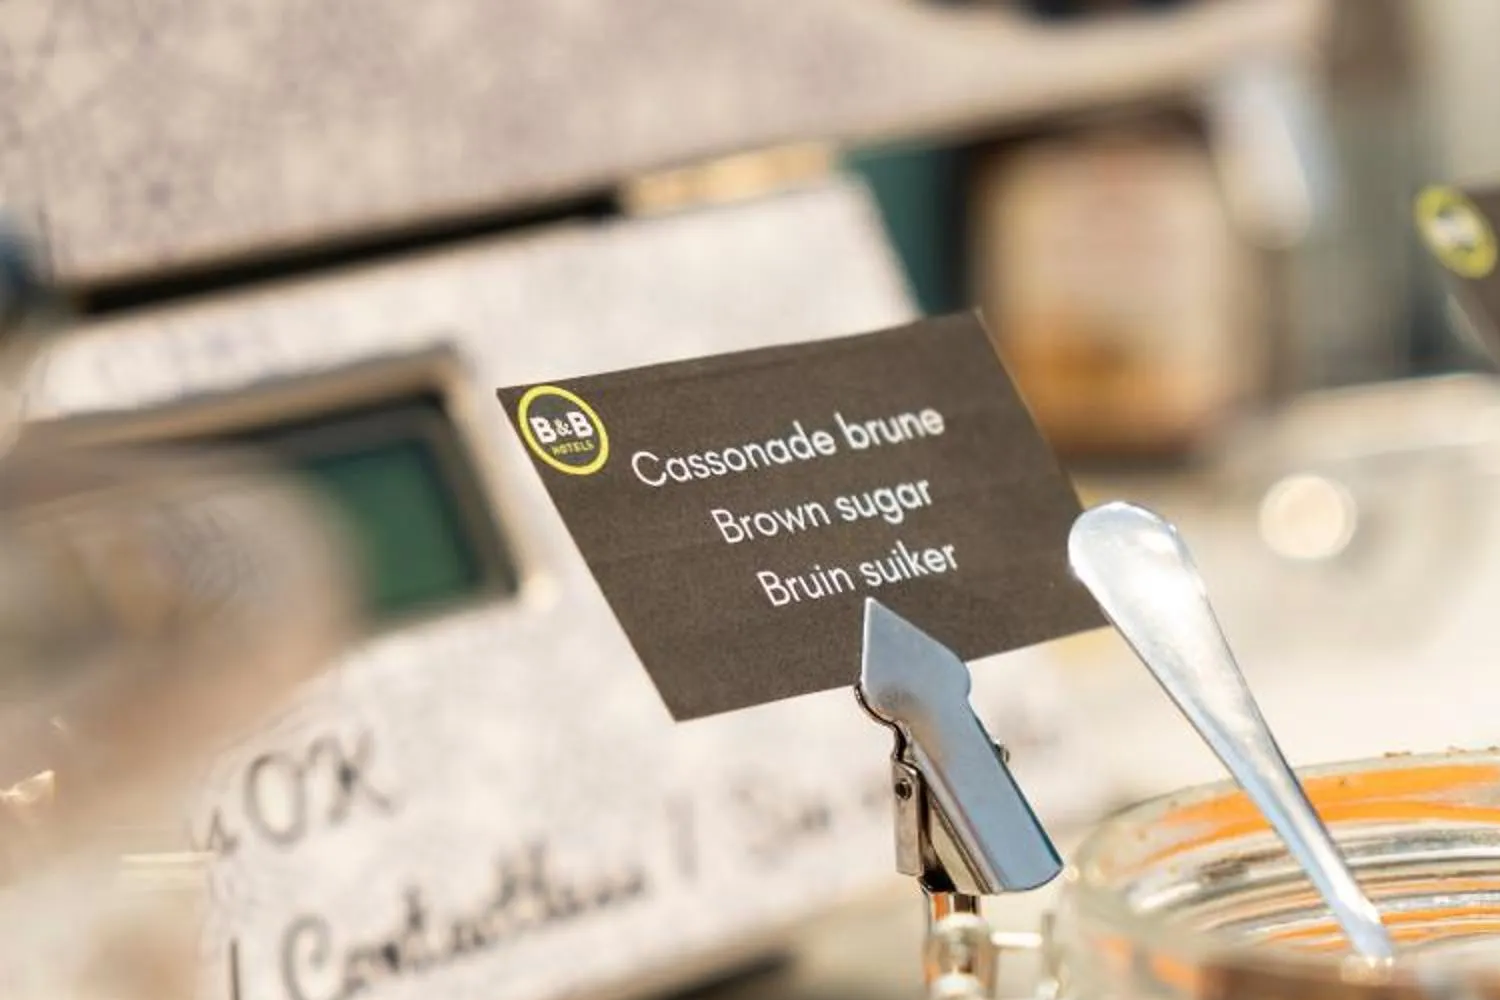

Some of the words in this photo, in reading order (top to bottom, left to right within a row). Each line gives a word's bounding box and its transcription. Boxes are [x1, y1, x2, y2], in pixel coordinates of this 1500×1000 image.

[529, 411, 593, 444] B&B
[551, 439, 595, 456] HOTELS
[631, 420, 835, 487] Cassonade
[834, 407, 945, 450] brune
[711, 496, 831, 544] Brown
[833, 476, 932, 525] sugar
[757, 565, 856, 607] Bruin
[859, 541, 958, 588] suiker
